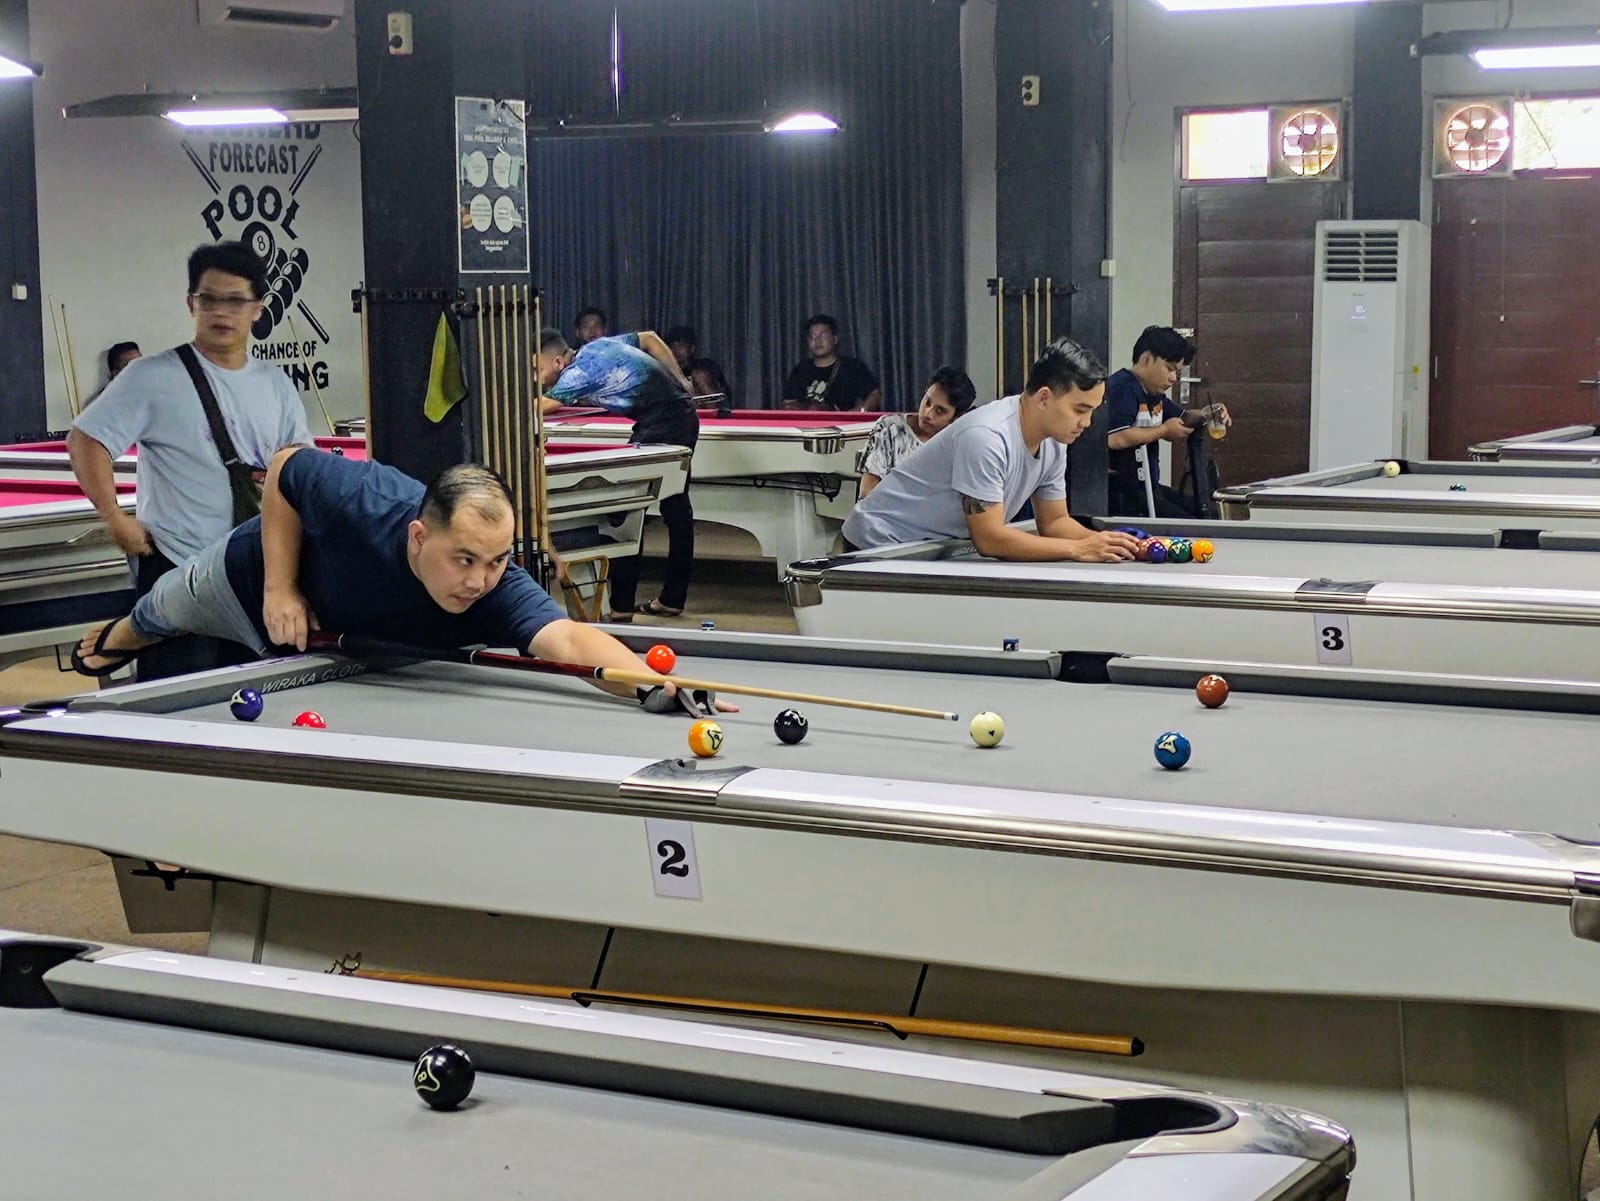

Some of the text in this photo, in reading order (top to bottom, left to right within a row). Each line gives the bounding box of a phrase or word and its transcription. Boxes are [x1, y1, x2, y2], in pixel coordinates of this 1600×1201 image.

[208, 142, 299, 175] FORECAST
[201, 184, 300, 241] POOL
[256, 234, 266, 251] 8
[251, 340, 317, 361] CHANCE OF
[1321, 626, 1344, 651] 3
[261, 662, 368, 694] WIRAKA CLOTH
[657, 839, 689, 877] 2
